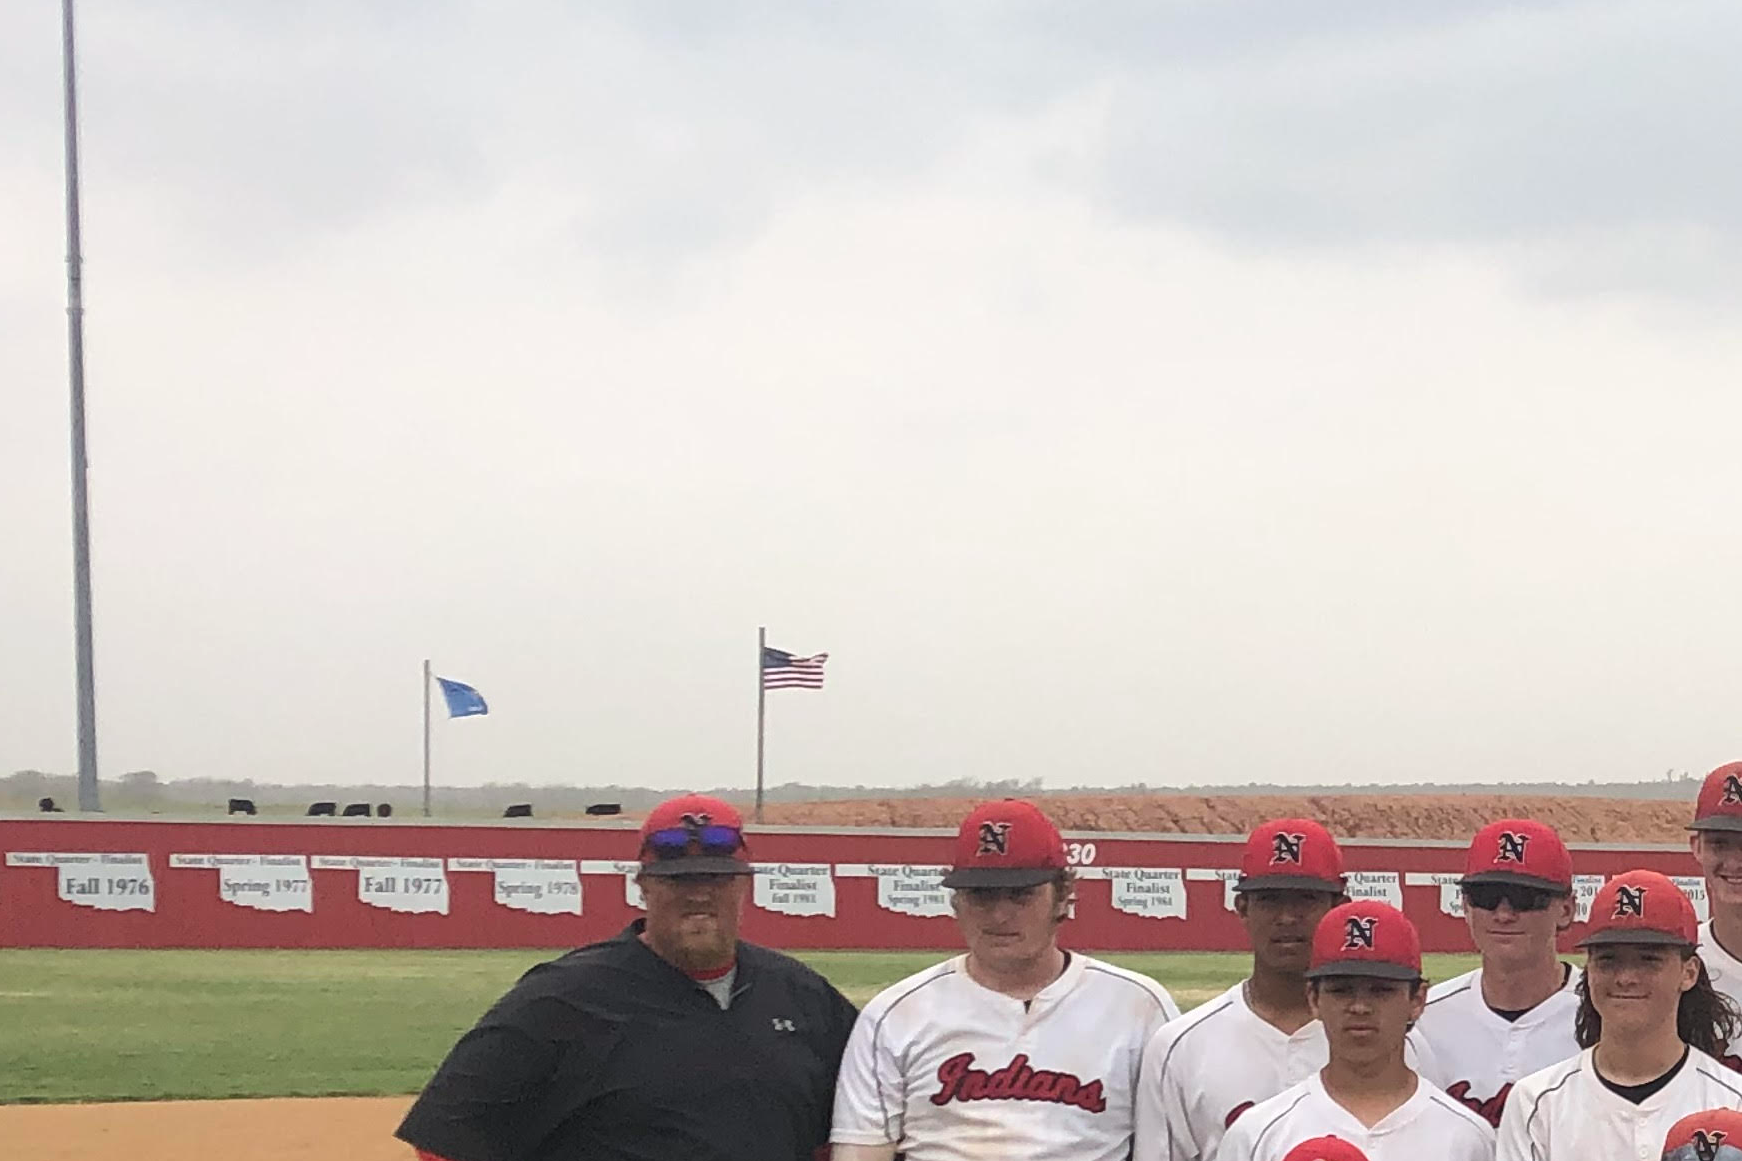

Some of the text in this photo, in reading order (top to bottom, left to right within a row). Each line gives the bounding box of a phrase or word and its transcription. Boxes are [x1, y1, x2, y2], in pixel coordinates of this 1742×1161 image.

[976, 821, 1011, 856] N
[1494, 830, 1530, 865] N
[1062, 843, 1096, 865] 30
[1269, 831, 1306, 866] N
[779, 865, 828, 877] Quarter
[868, 866, 899, 876] State
[1102, 868, 1179, 882] State Quarter
[1354, 873, 1397, 885] Quarter
[66, 878, 150, 896] Fall 1976
[223, 879, 308, 897] Spring 1977
[364, 877, 442, 894] Fall 1977
[498, 881, 543, 899] Spring
[769, 879, 817, 890] Finalist
[1126, 882, 1171, 894] Finalist
[888, 895, 920, 907] Spring
[1118, 896, 1148, 909] Spring
[1611, 884, 1649, 919] N
[1340, 915, 1379, 951] N
[930, 1052, 1107, 1113] Indians
